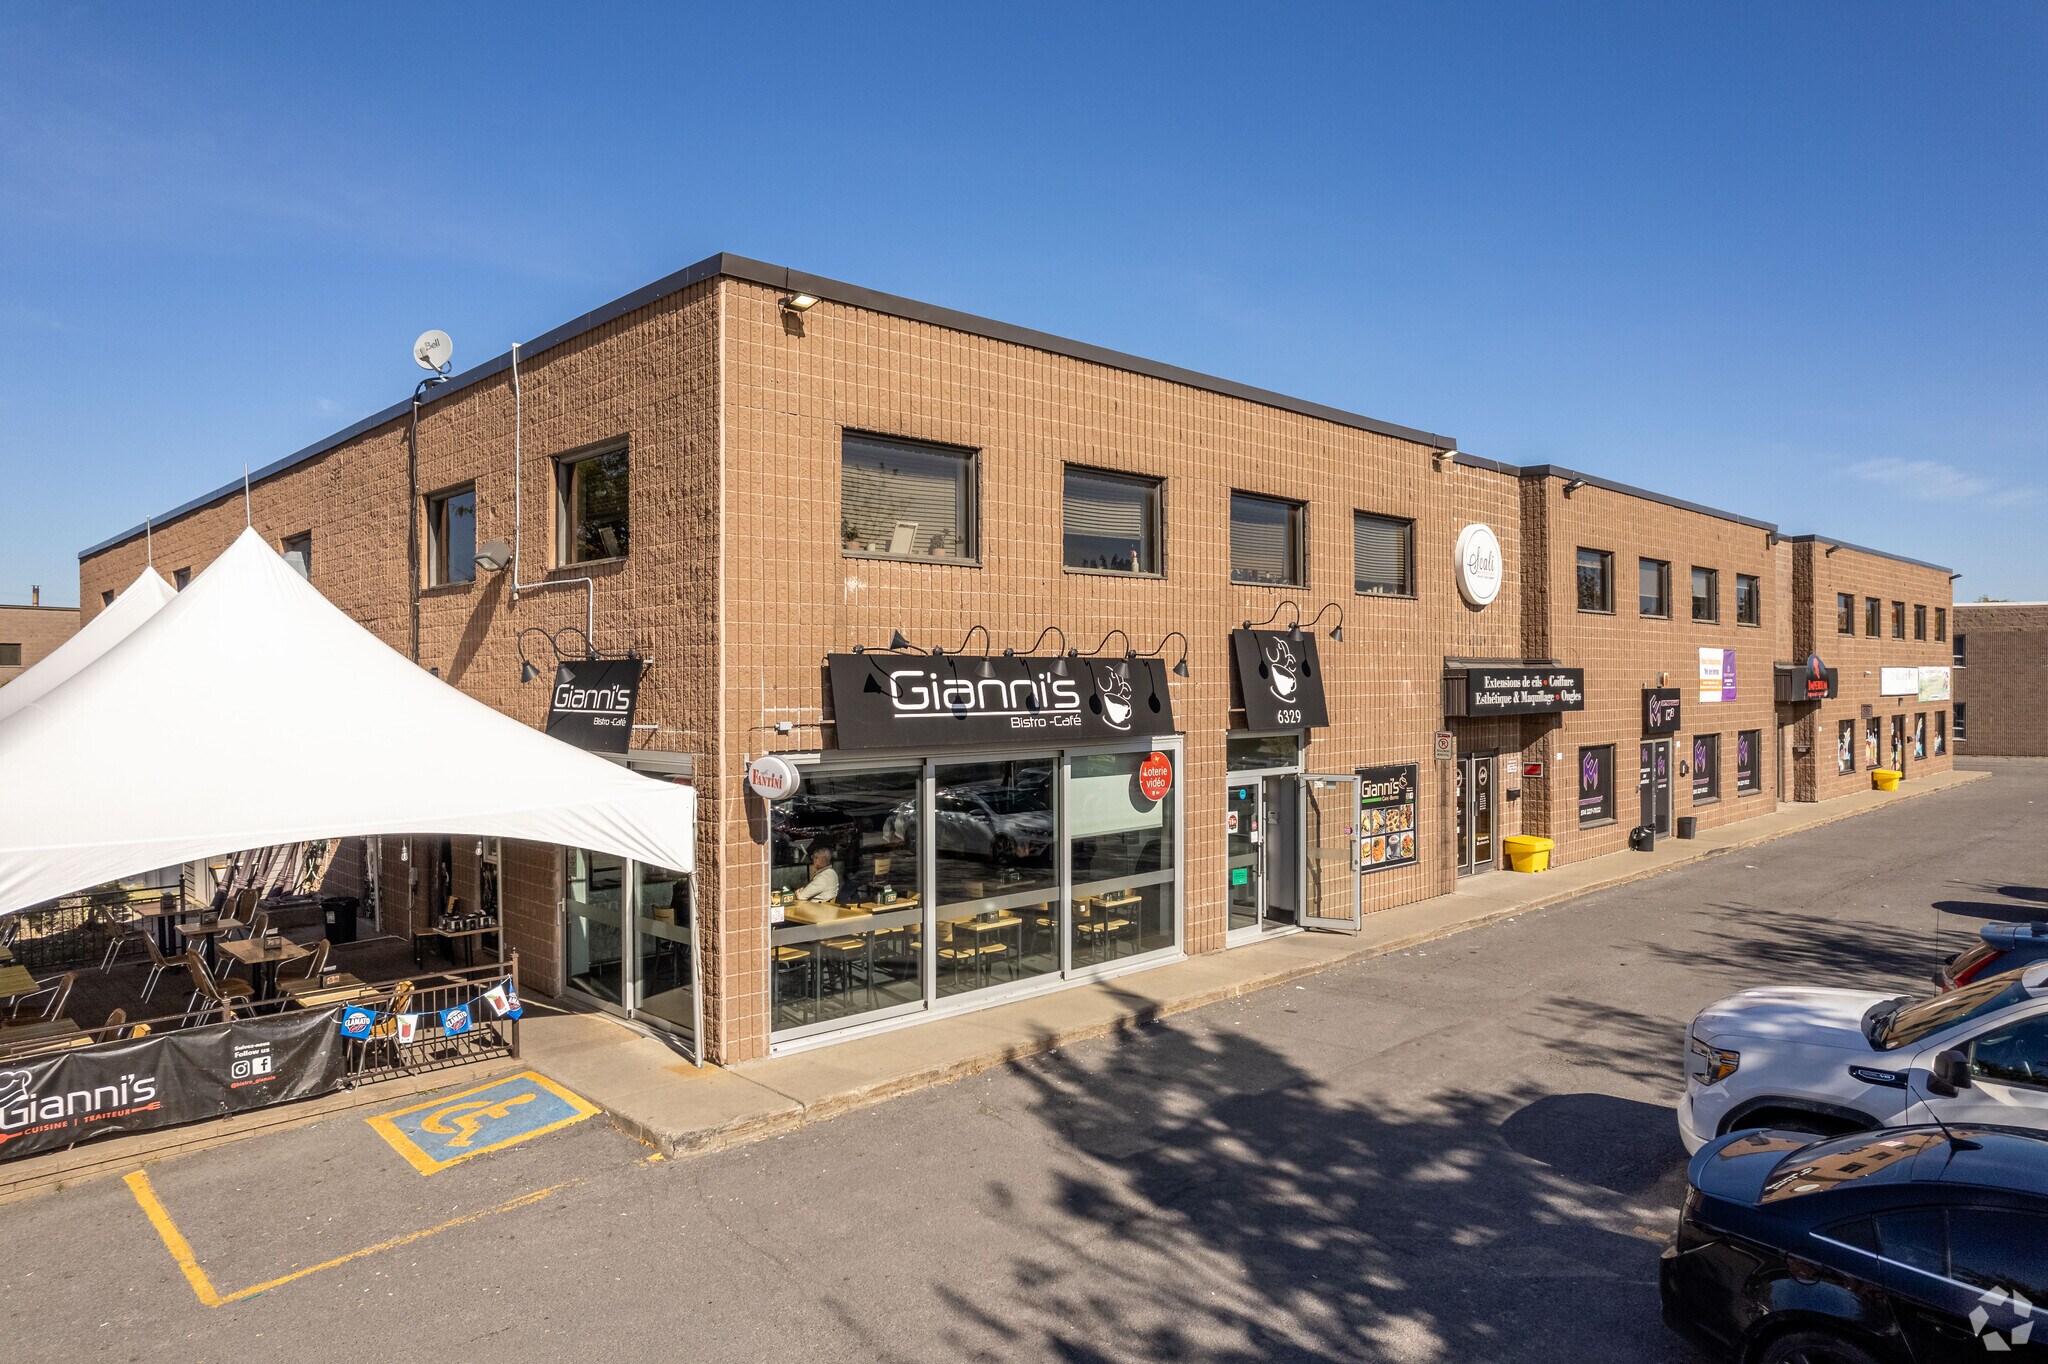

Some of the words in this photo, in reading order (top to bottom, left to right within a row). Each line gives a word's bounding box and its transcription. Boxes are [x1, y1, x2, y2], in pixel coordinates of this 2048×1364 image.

[1484, 676, 1521, 689] Extensions
[1522, 676, 1531, 688] de
[1531, 675, 1543, 688] cils
[1549, 675, 1574, 687] Coiffure
[554, 683, 631, 710] Gianni's
[889, 670, 1081, 711] Gianni's
[1475, 692, 1512, 708] Esthétique
[1513, 691, 1520, 703] &
[1521, 690, 1554, 706] Maquillage
[1561, 690, 1582, 704] Ongles
[593, 717, 610, 726] Bistro
[1010, 716, 1047, 729] Bistro
[1277, 709, 1302, 724] 6329
[1143, 766, 1168, 777] Loterie
[1146, 777, 1166, 788] vidéo
[1361, 778, 1400, 798] Gianni's
[345, 1017, 371, 1027] CLAMATO
[446, 1010, 468, 1028] CLAMATO
[234, 1041, 271, 1052] Suivez-nous
[234, 1049, 260, 1059] Follow
[0, 1073, 156, 1130] Gianni's
[24, 1119, 69, 1136] CUISINE
[83, 1107, 132, 1123] TRAITEUR
